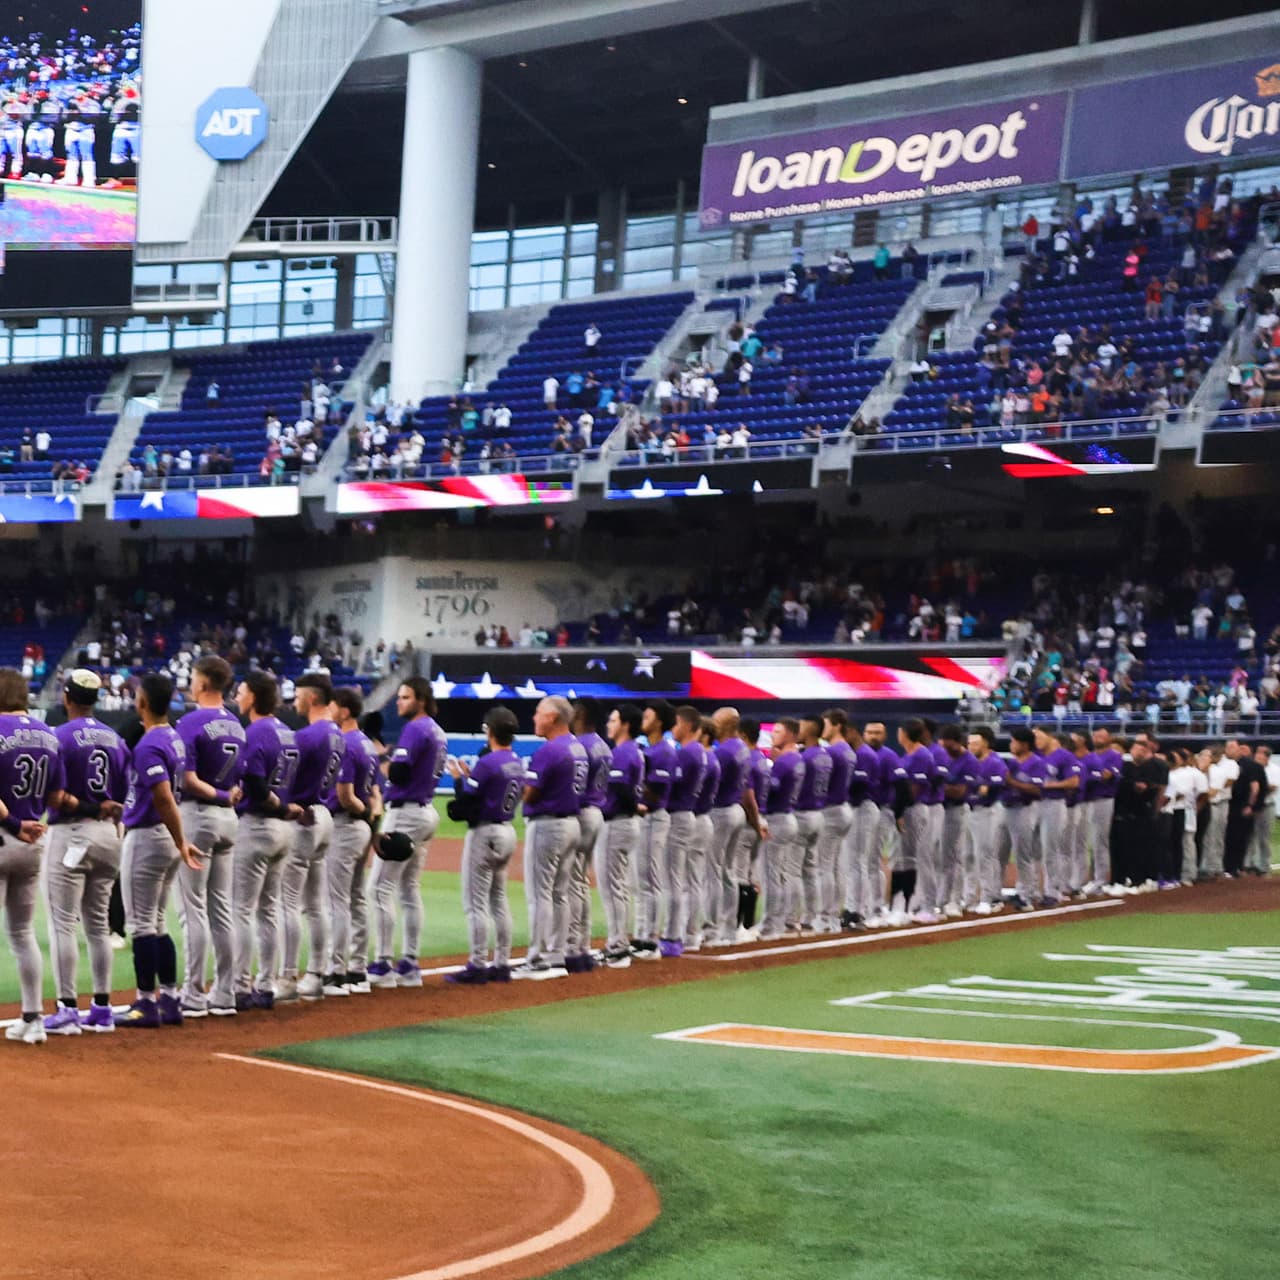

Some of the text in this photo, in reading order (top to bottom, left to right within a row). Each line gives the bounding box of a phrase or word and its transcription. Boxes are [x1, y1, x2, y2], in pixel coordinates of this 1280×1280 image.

[202, 108, 260, 136] ADT
[731, 110, 1028, 198] loanDepot
[729, 209, 765, 222] Home
[826, 196, 862, 210] Home
[11, 753, 49, 799] 31
[87, 749, 109, 793] 3
[215, 742, 240, 784] 7
